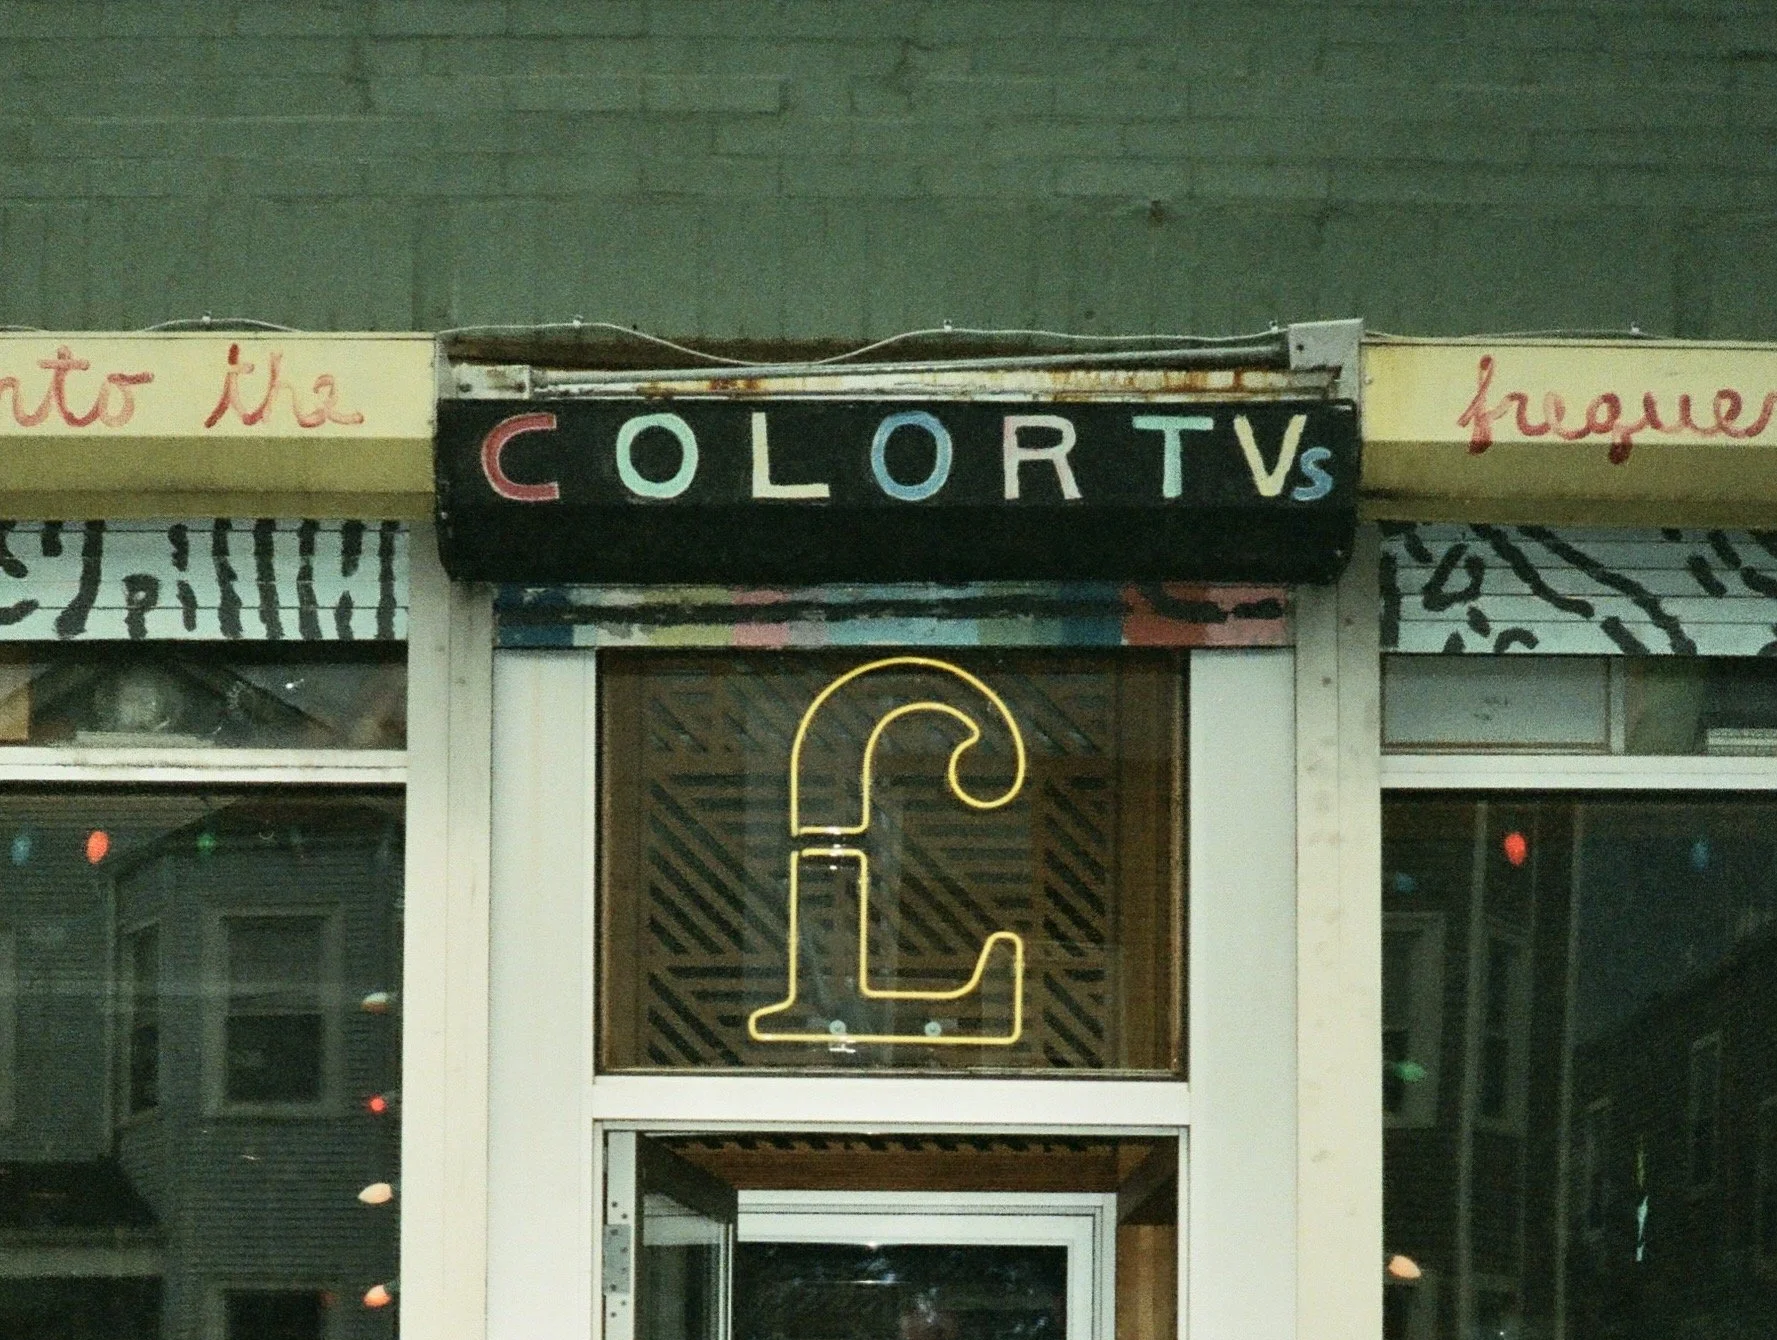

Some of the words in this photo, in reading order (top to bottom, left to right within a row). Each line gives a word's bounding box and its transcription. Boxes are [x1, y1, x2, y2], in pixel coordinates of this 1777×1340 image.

[204, 342, 365, 428] the
[481, 410, 1083, 502] COLOR
[1132, 414, 1333, 501] TVs
